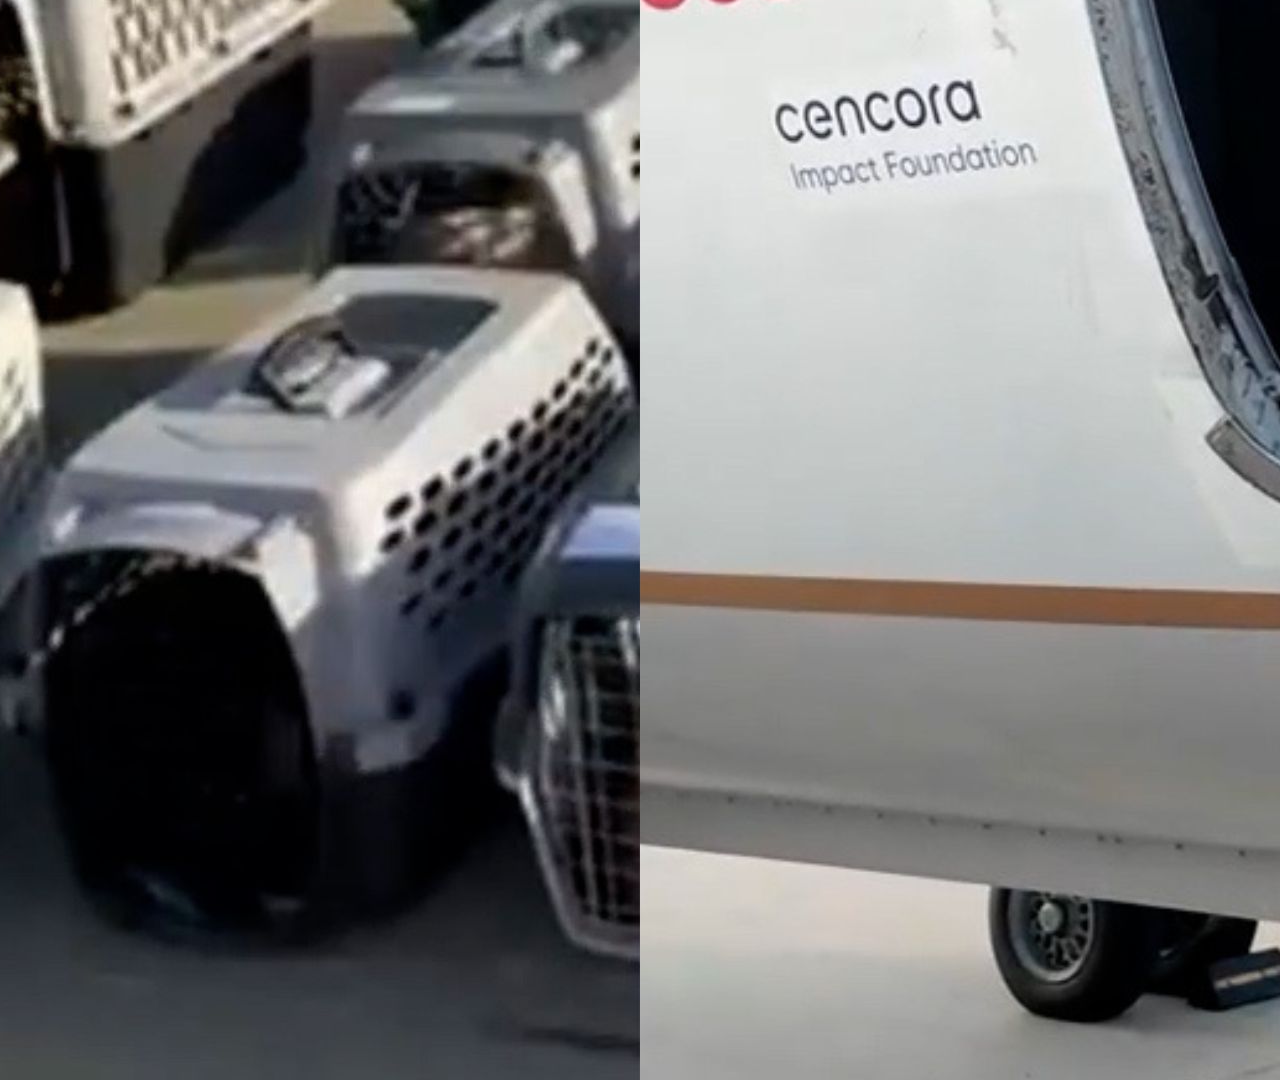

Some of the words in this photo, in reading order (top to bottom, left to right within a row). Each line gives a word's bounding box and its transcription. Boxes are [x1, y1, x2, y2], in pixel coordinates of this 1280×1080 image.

[774, 78, 982, 144] cencora
[791, 157, 881, 193] Impact
[884, 139, 1038, 181] Foundation
